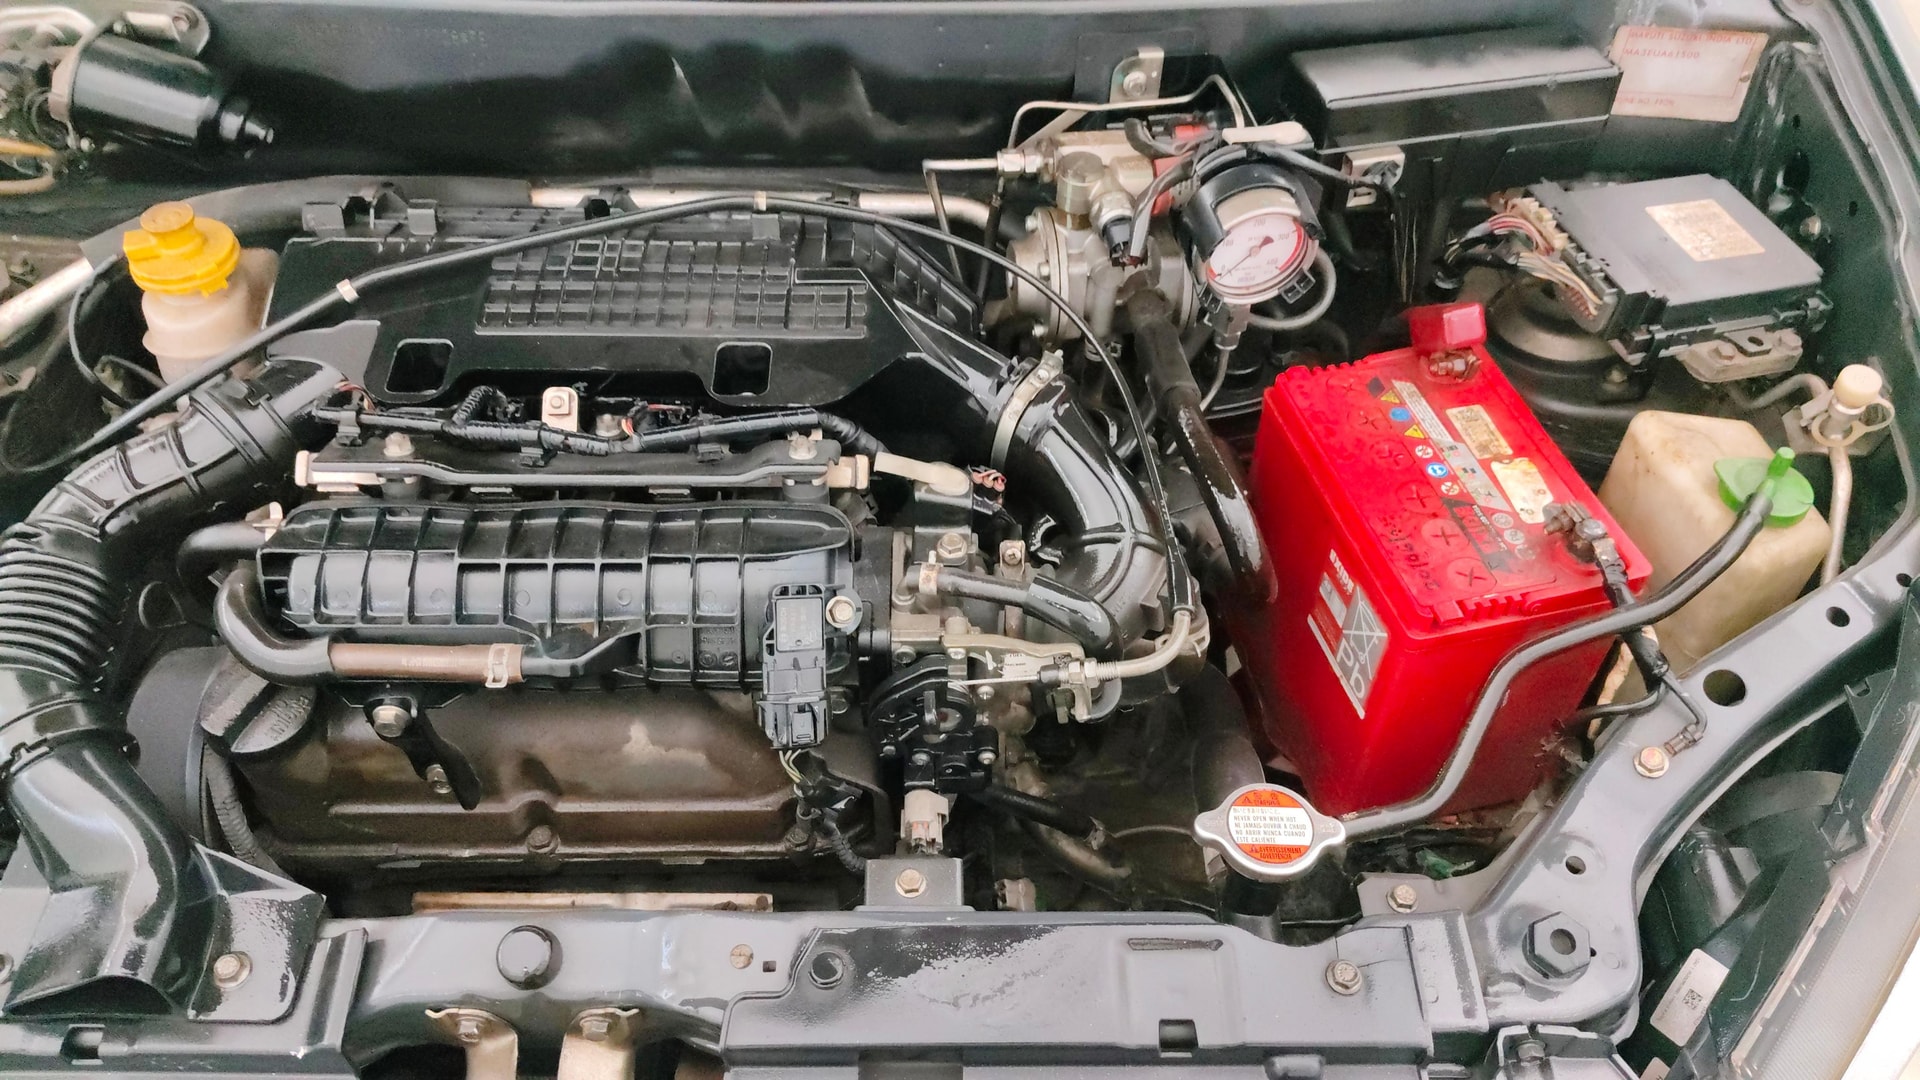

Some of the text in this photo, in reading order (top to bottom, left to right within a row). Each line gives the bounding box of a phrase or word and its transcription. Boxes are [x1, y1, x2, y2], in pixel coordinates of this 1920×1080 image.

[1630, 31, 1665, 41] MARUTI
[1669, 33, 1702, 43] SUZUKI
[1706, 34, 1732, 43] INDIA
[1254, 219, 1266, 227] 200
[1329, 548, 1355, 594] EXIDE
[1337, 637, 1366, 699] Pb
